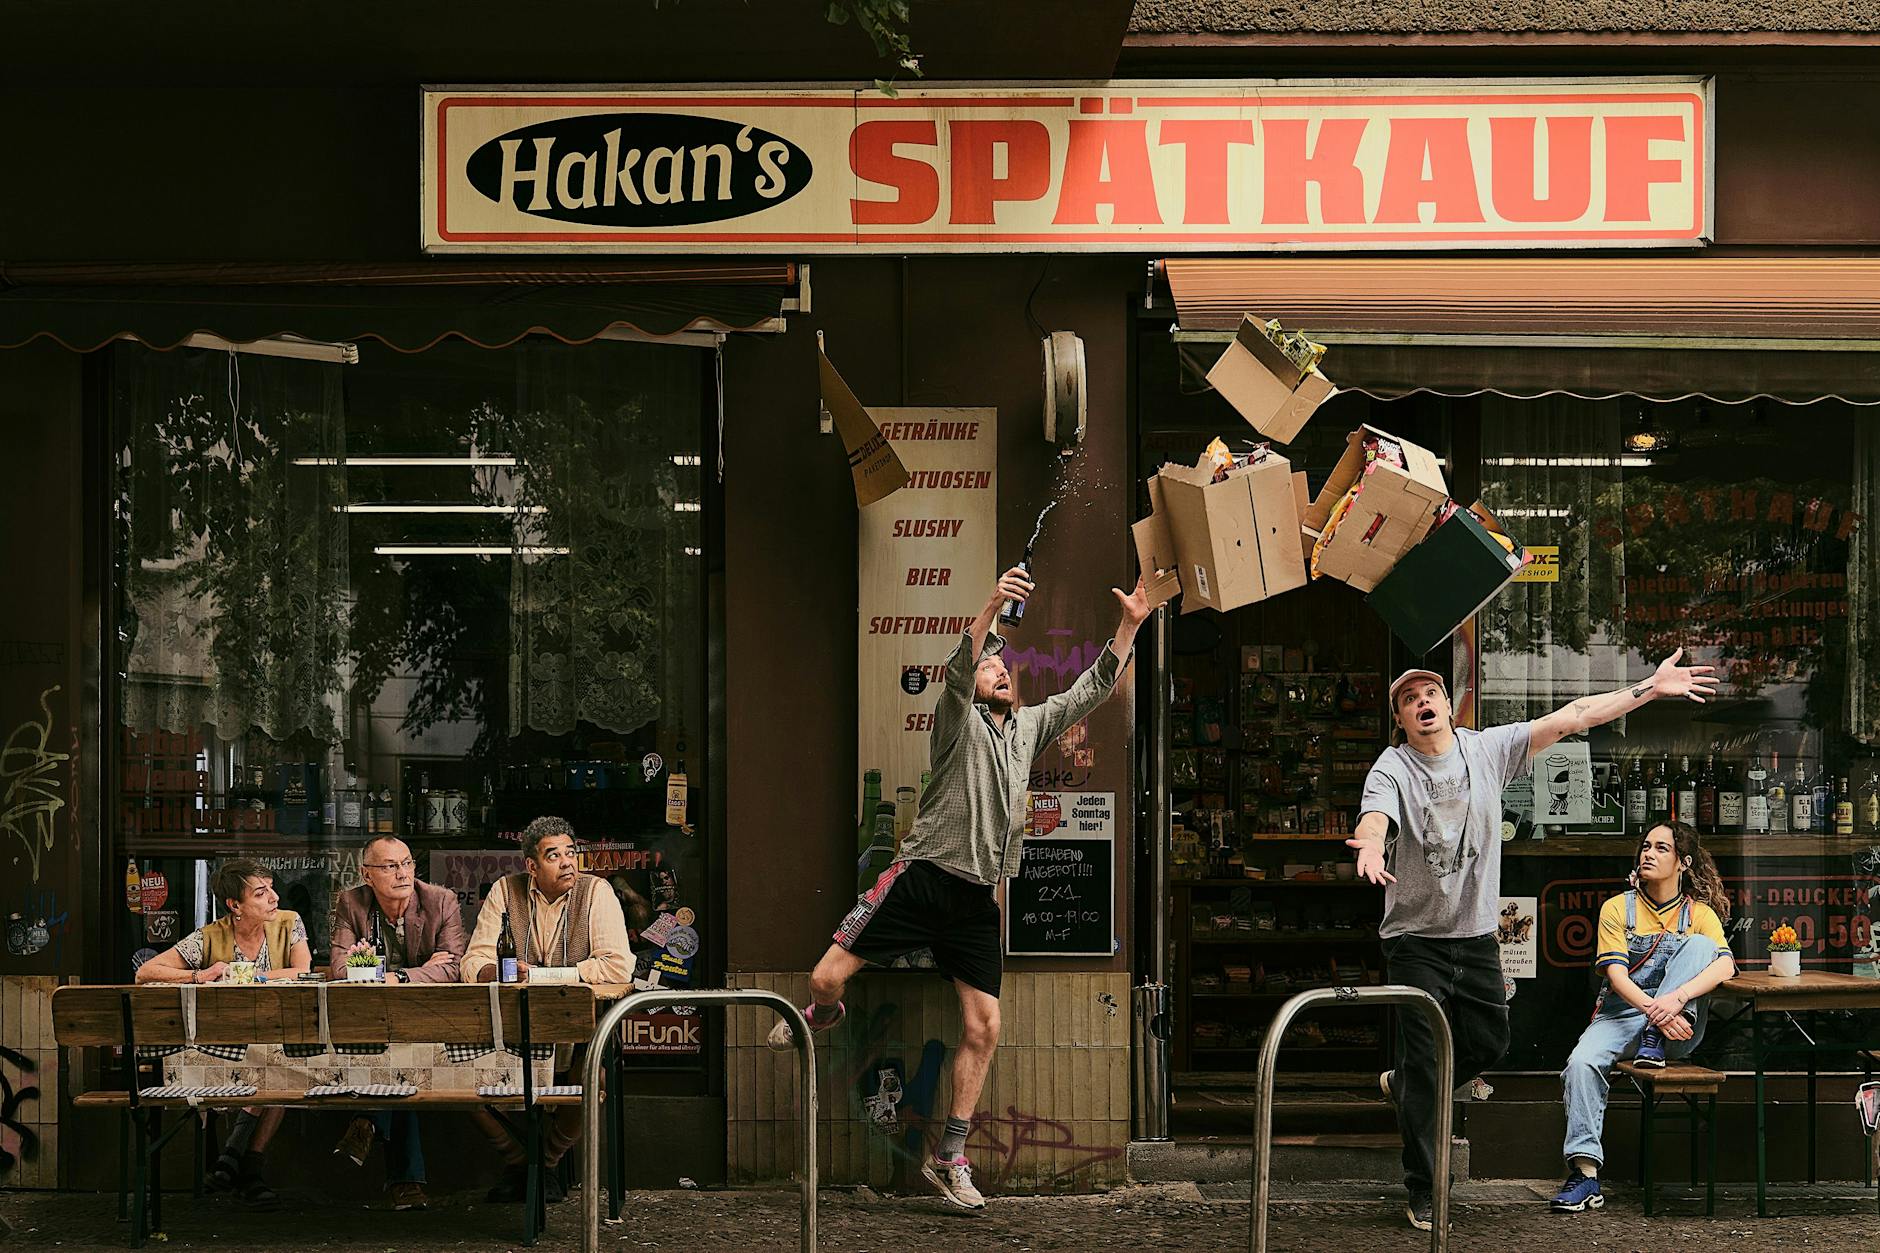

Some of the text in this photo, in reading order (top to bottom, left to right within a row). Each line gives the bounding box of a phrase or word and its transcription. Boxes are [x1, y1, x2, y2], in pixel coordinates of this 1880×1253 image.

[848, 97, 1686, 225] SPÄTKAUF
[880, 419, 979, 440] GETRÄNKE
[892, 519, 964, 537] SLUSHY
[906, 568, 951, 586] BIER
[1034, 799, 1058, 809] NEU!
[1077, 796, 1105, 806] Jeden
[1072, 808, 1110, 819] Sonntag
[1080, 821, 1102, 831] hier!
[1022, 846, 1083, 861] FEIERABEND
[141, 876, 165, 888] NEU!
[1761, 918, 1777, 931] ab
